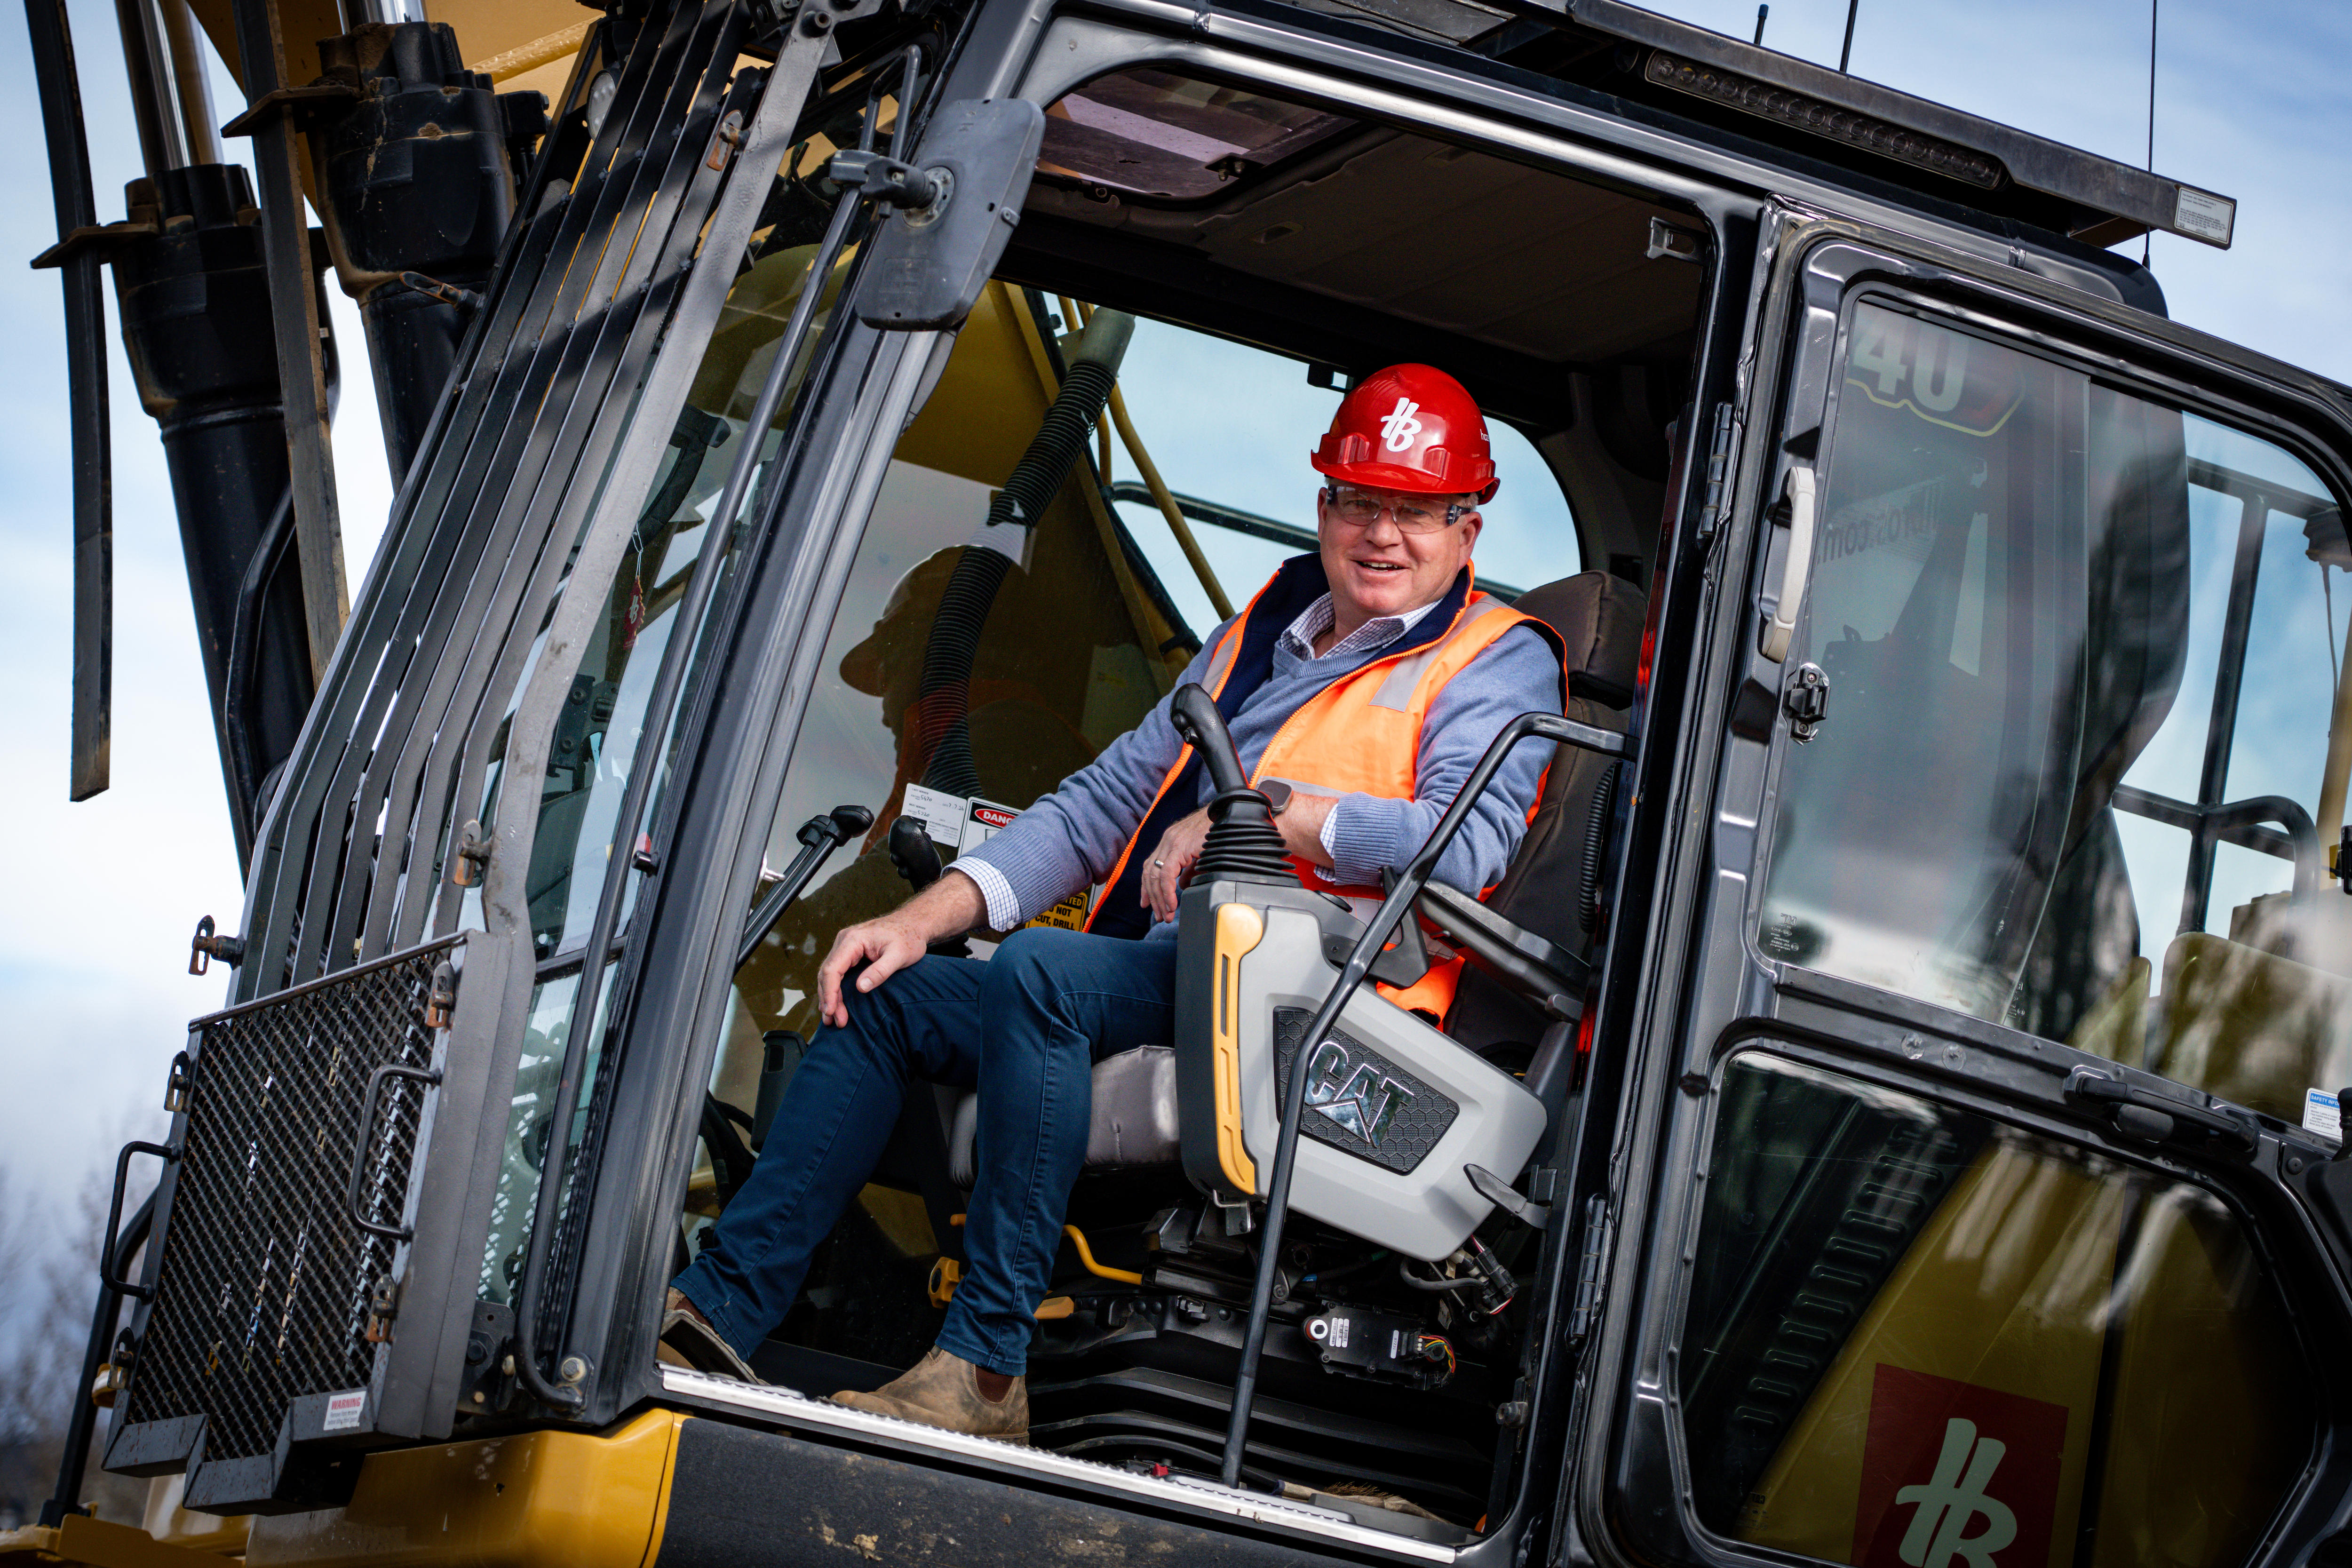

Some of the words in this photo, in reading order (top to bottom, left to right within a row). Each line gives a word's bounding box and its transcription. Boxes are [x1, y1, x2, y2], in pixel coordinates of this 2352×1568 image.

[1056, 906, 1072, 917] NOT
[1035, 914, 1051, 926] CUT,
[1053, 918, 1075, 931] DRILL
[1305, 1041, 1414, 1148] CAT
[2311, 1095, 2328, 1103] SAFETY
[331, 1397, 362, 1410] WARNING
